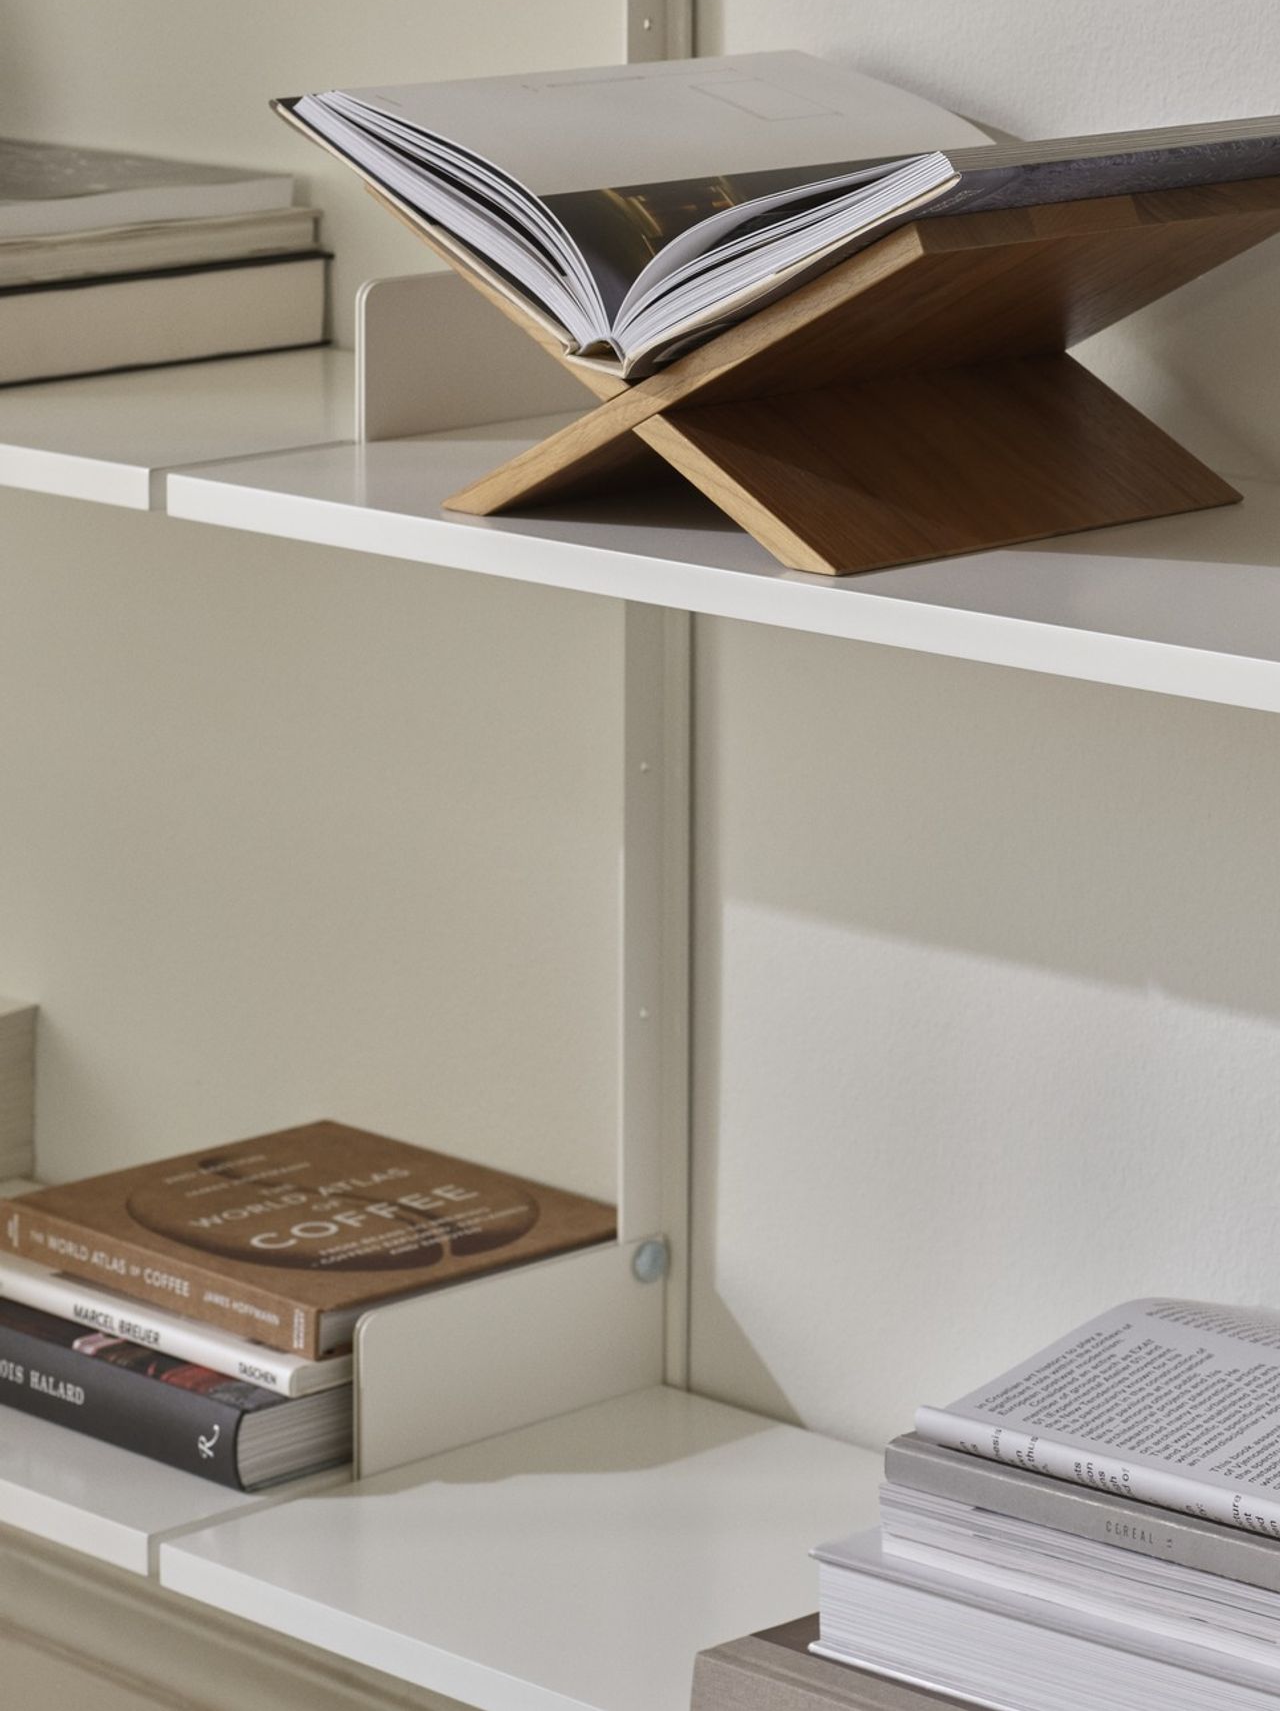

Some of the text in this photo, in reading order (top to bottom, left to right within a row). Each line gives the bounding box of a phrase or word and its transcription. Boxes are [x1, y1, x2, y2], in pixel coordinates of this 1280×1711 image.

[190, 1192, 307, 1229] WORLD
[318, 1166, 411, 1199] ATLAS
[250, 1183, 480, 1251] COFFEE
[47, 1233, 89, 1261] WORLD
[90, 1251, 126, 1276] ATLAS
[143, 1268, 191, 1298] COFFEE
[73, 1303, 161, 1346] MARCEL BREUER
[29, 1371, 85, 1406] HALARD
[238, 1361, 278, 1386] TASCHEN
